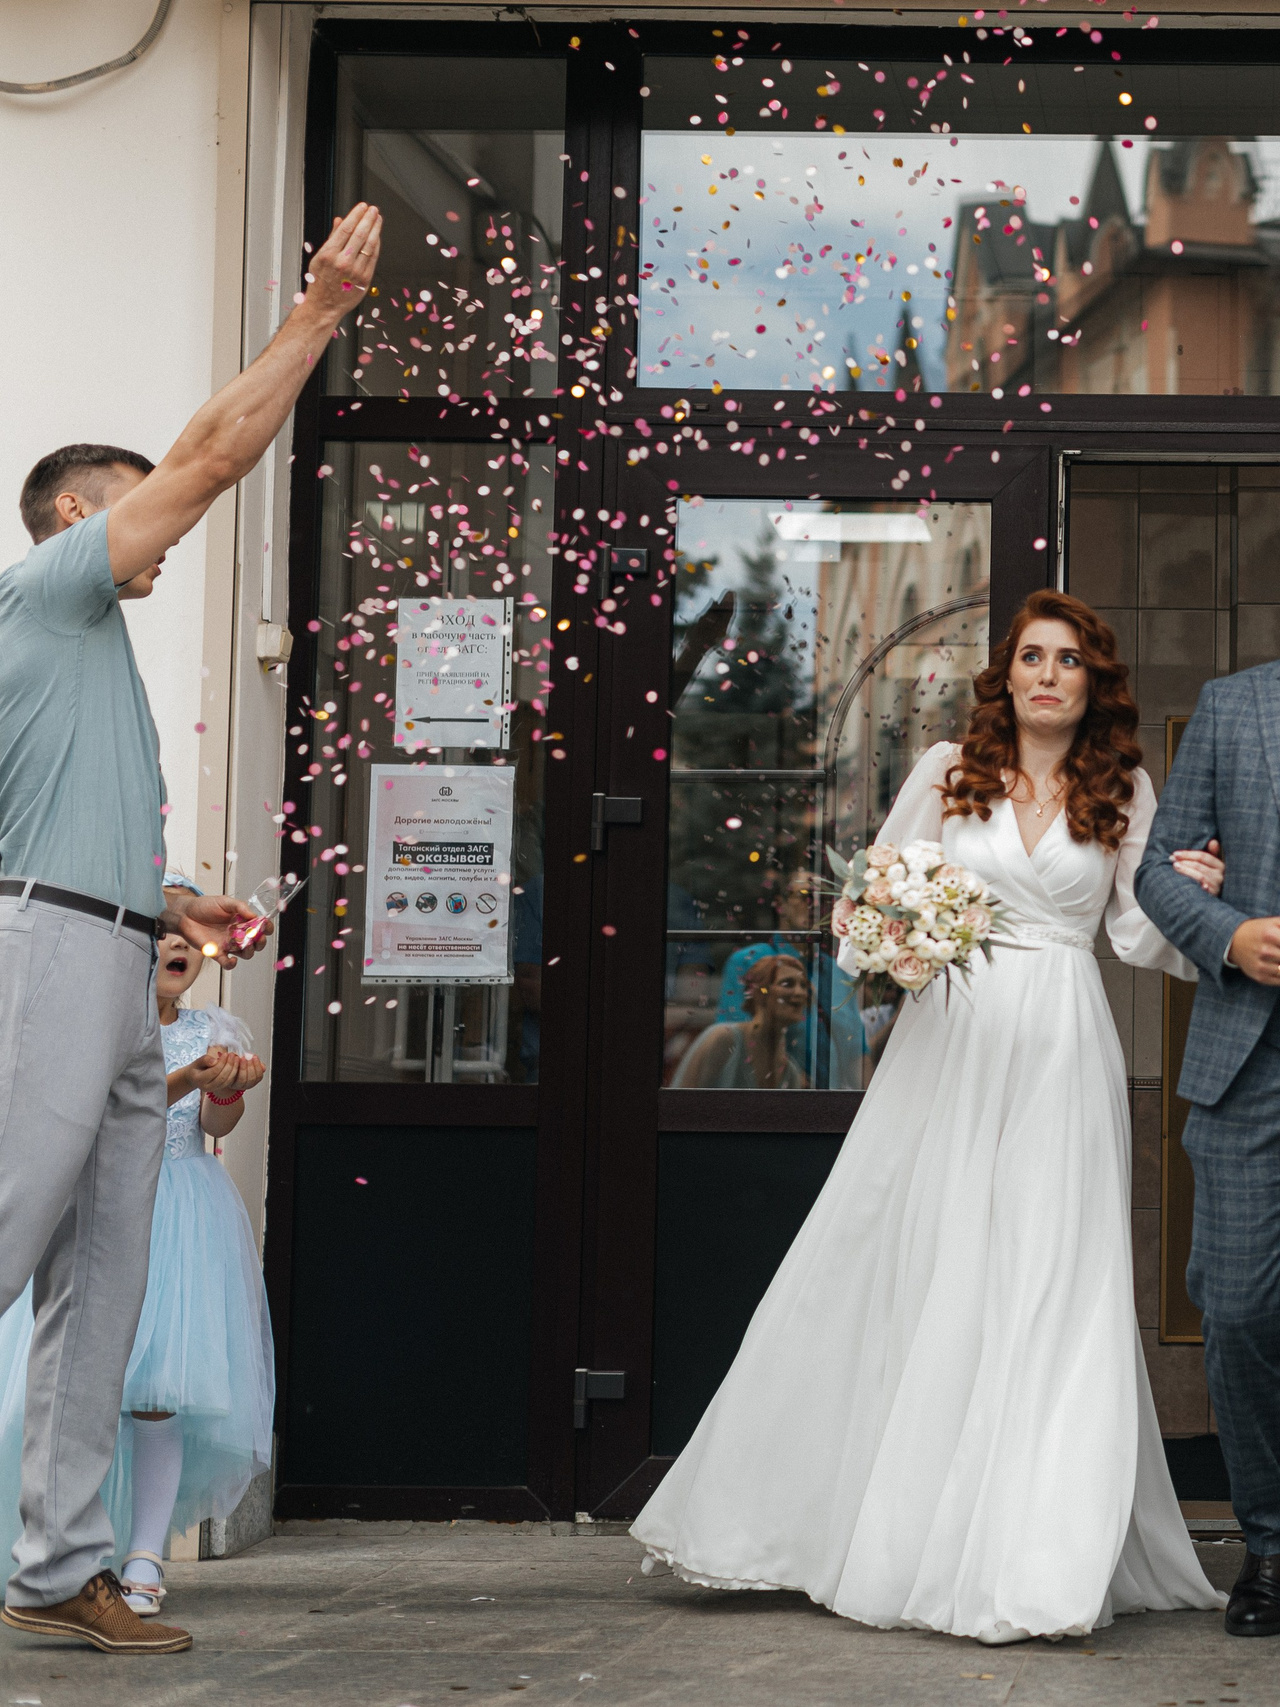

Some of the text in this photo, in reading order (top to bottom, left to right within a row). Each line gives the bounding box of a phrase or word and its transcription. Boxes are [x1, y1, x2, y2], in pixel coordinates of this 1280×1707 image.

[468, 632, 496, 640] часть
[394, 816, 492, 826] Дорогие молодожёны!
[398, 844, 440, 852] Таганский
[396, 854, 492, 863] не оказывает
[459, 874, 482, 882] голуби
